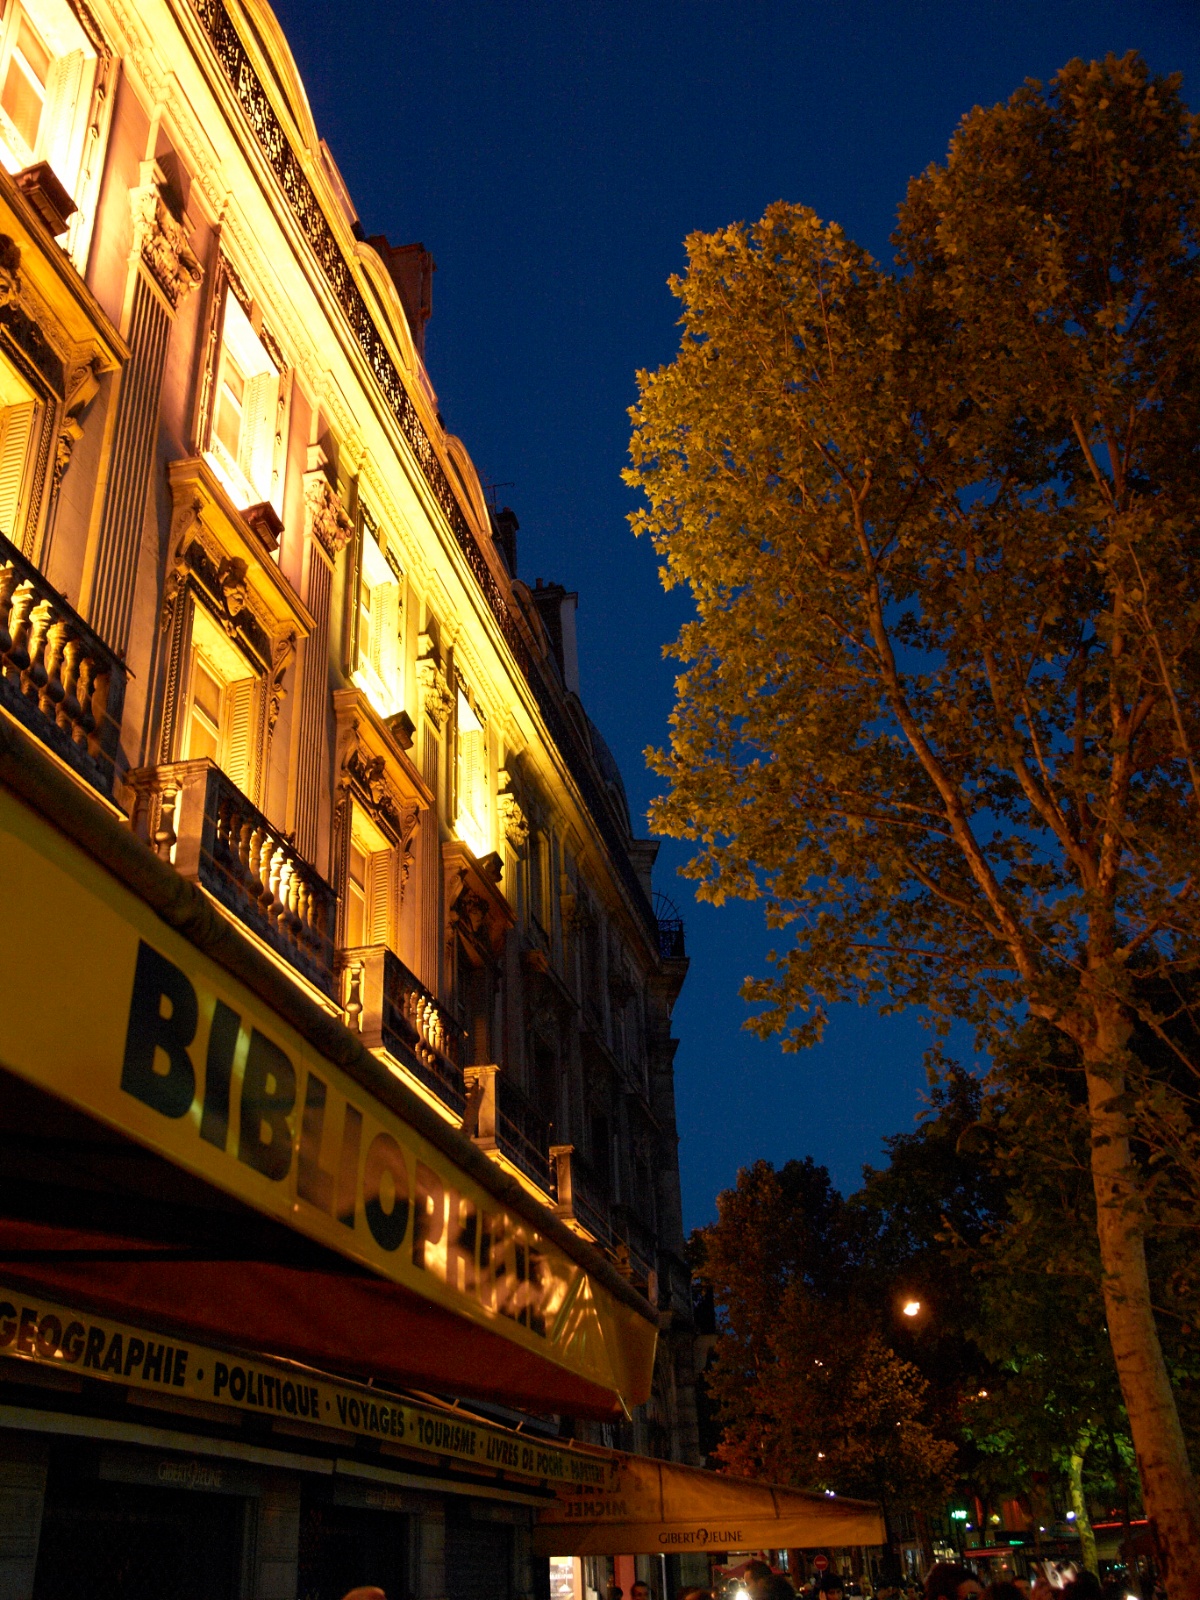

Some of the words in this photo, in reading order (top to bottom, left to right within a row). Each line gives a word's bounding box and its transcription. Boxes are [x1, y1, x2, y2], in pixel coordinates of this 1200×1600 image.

[0, 1301, 189, 1387] GEOGRAPHIE
[213, 1361, 320, 1419] POLITIQUE
[336, 1394, 405, 1438] VOYAGES
[417, 1416, 476, 1456] TOURISME
[486, 1435, 519, 1468] LIVRES
[522, 1447, 534, 1472] DE
[537, 1451, 563, 1478] POCHE
[658, 1532, 696, 1544] GIBERT
[708, 1530, 743, 1543] JEUNE
